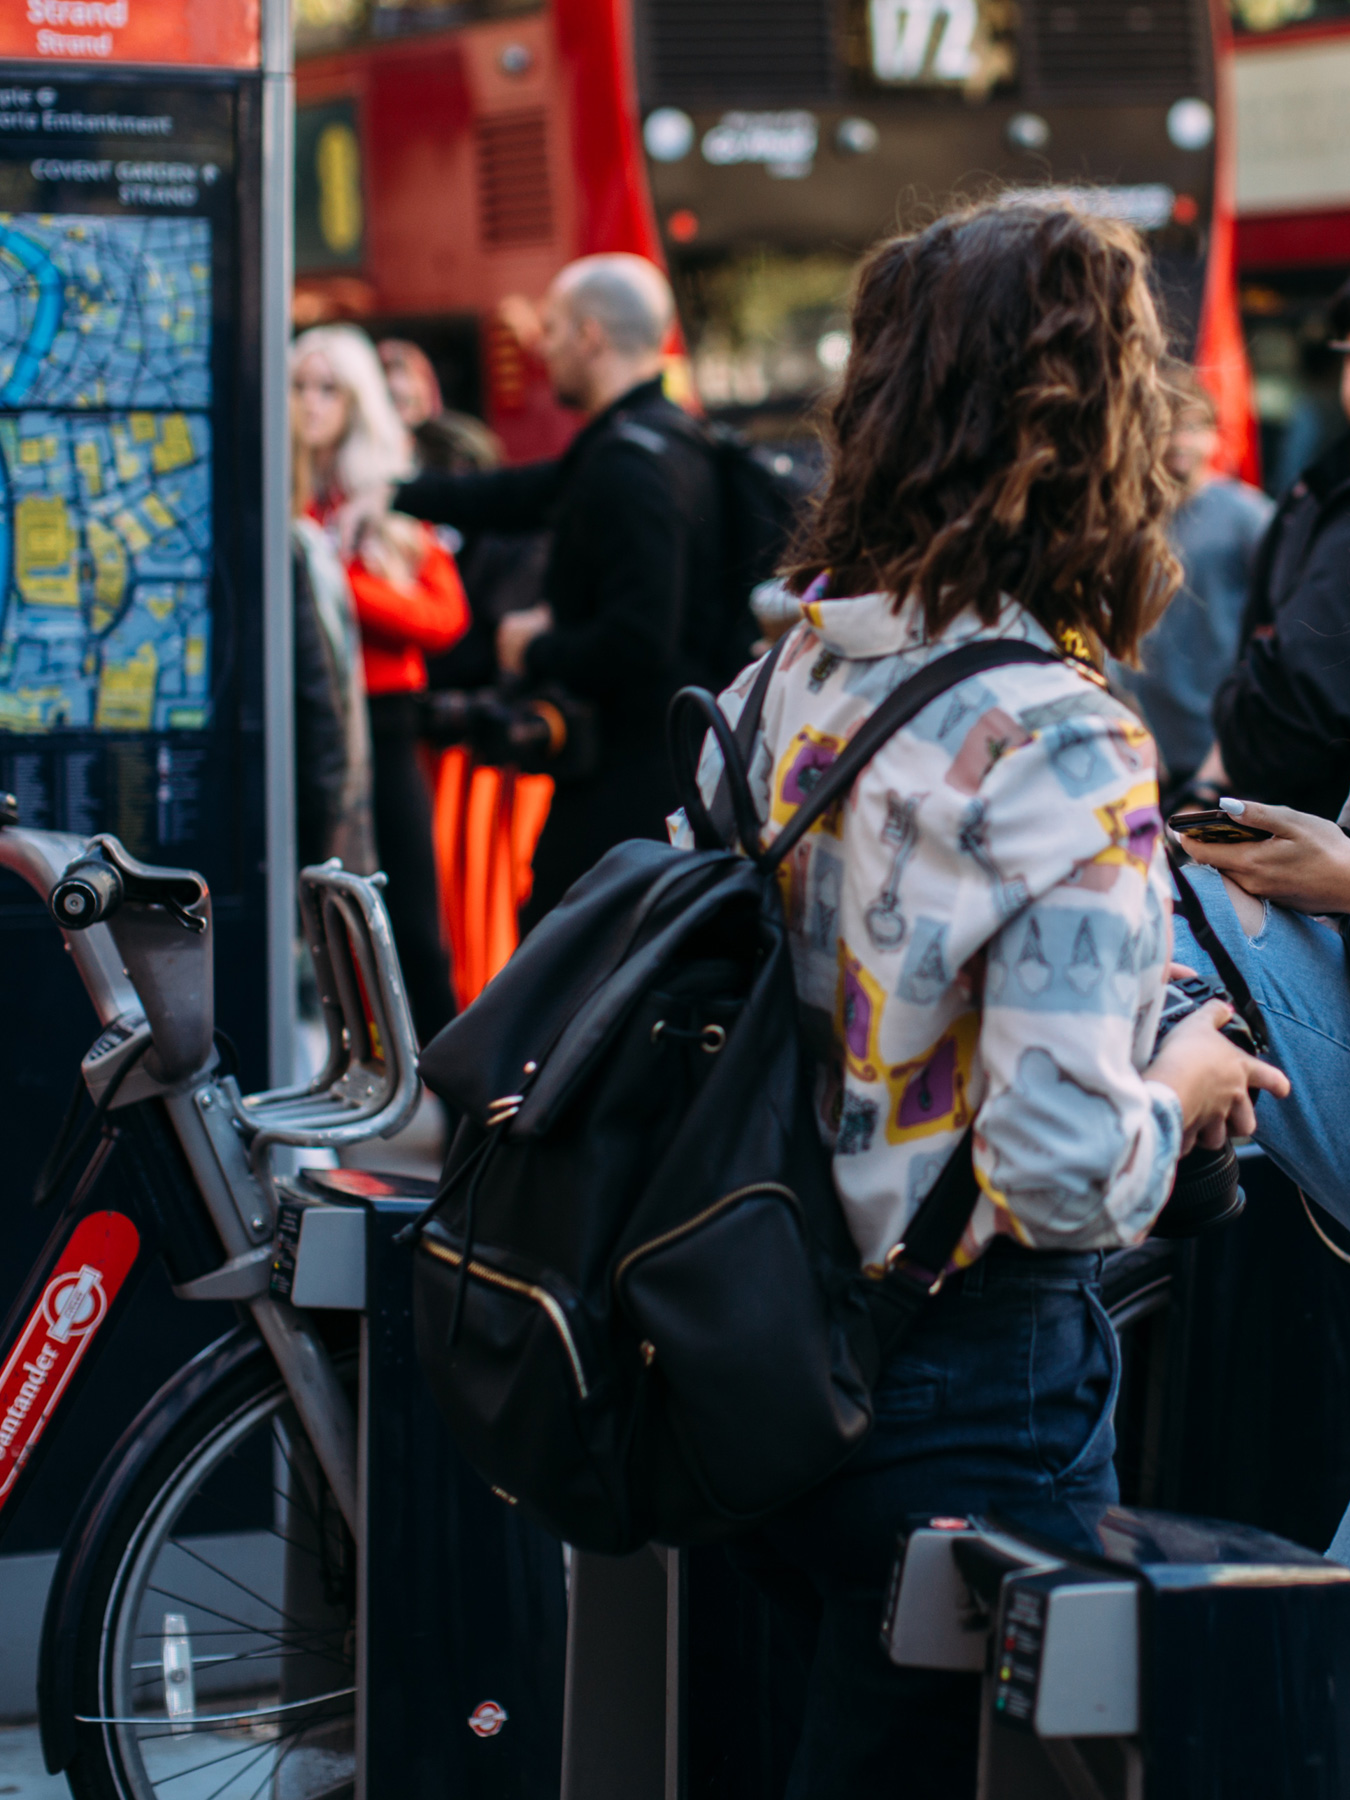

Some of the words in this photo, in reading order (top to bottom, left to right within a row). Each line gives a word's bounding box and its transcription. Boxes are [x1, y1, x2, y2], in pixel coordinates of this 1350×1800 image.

[27, 0, 128, 27] Strand
[37, 29, 113, 57] Strand
[869, 0, 980, 79] 172
[42, 110, 173, 134] Embankment
[31, 159, 113, 181] COVENT
[115, 161, 198, 183] GARDEN
[119, 183, 198, 206] STRAND
